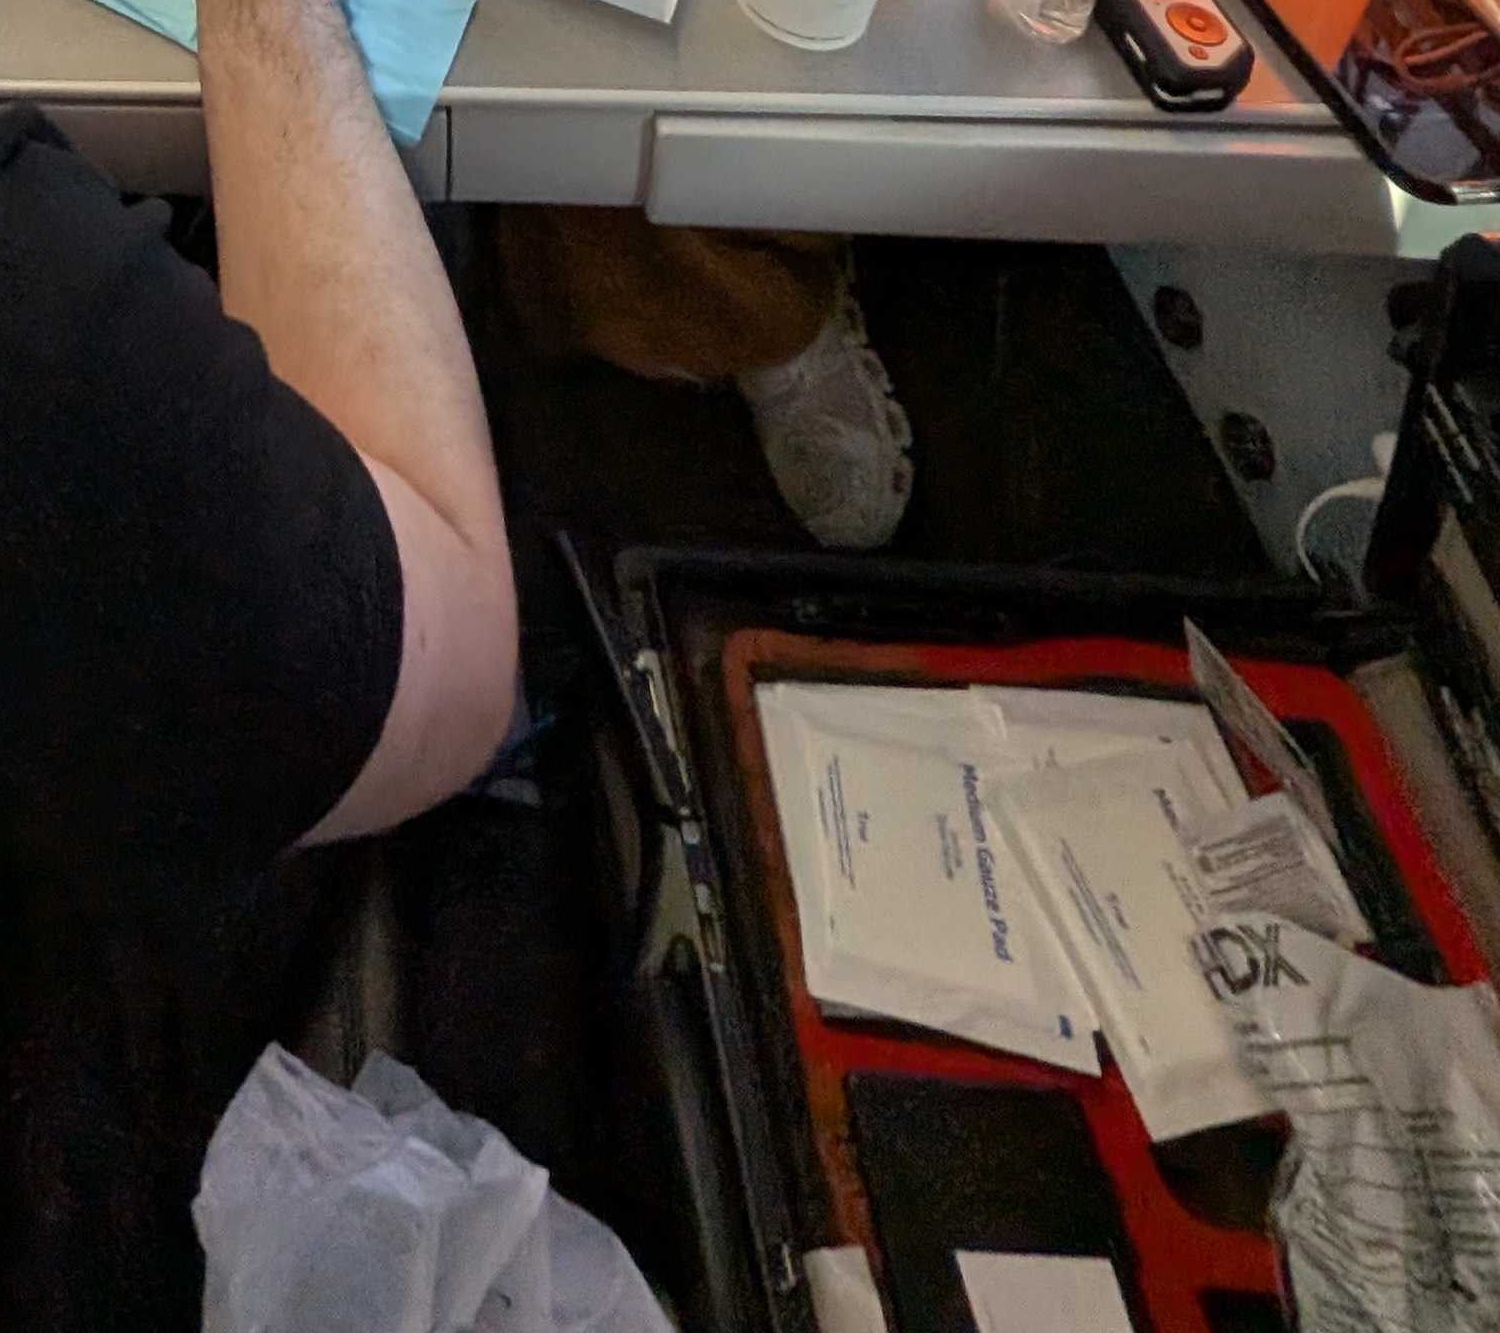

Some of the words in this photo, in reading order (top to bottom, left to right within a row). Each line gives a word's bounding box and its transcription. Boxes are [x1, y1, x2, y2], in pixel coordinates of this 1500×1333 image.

[962, 763, 986, 842] Medium
[977, 848, 1000, 912] Gauze
[991, 918, 1013, 962] Pad
